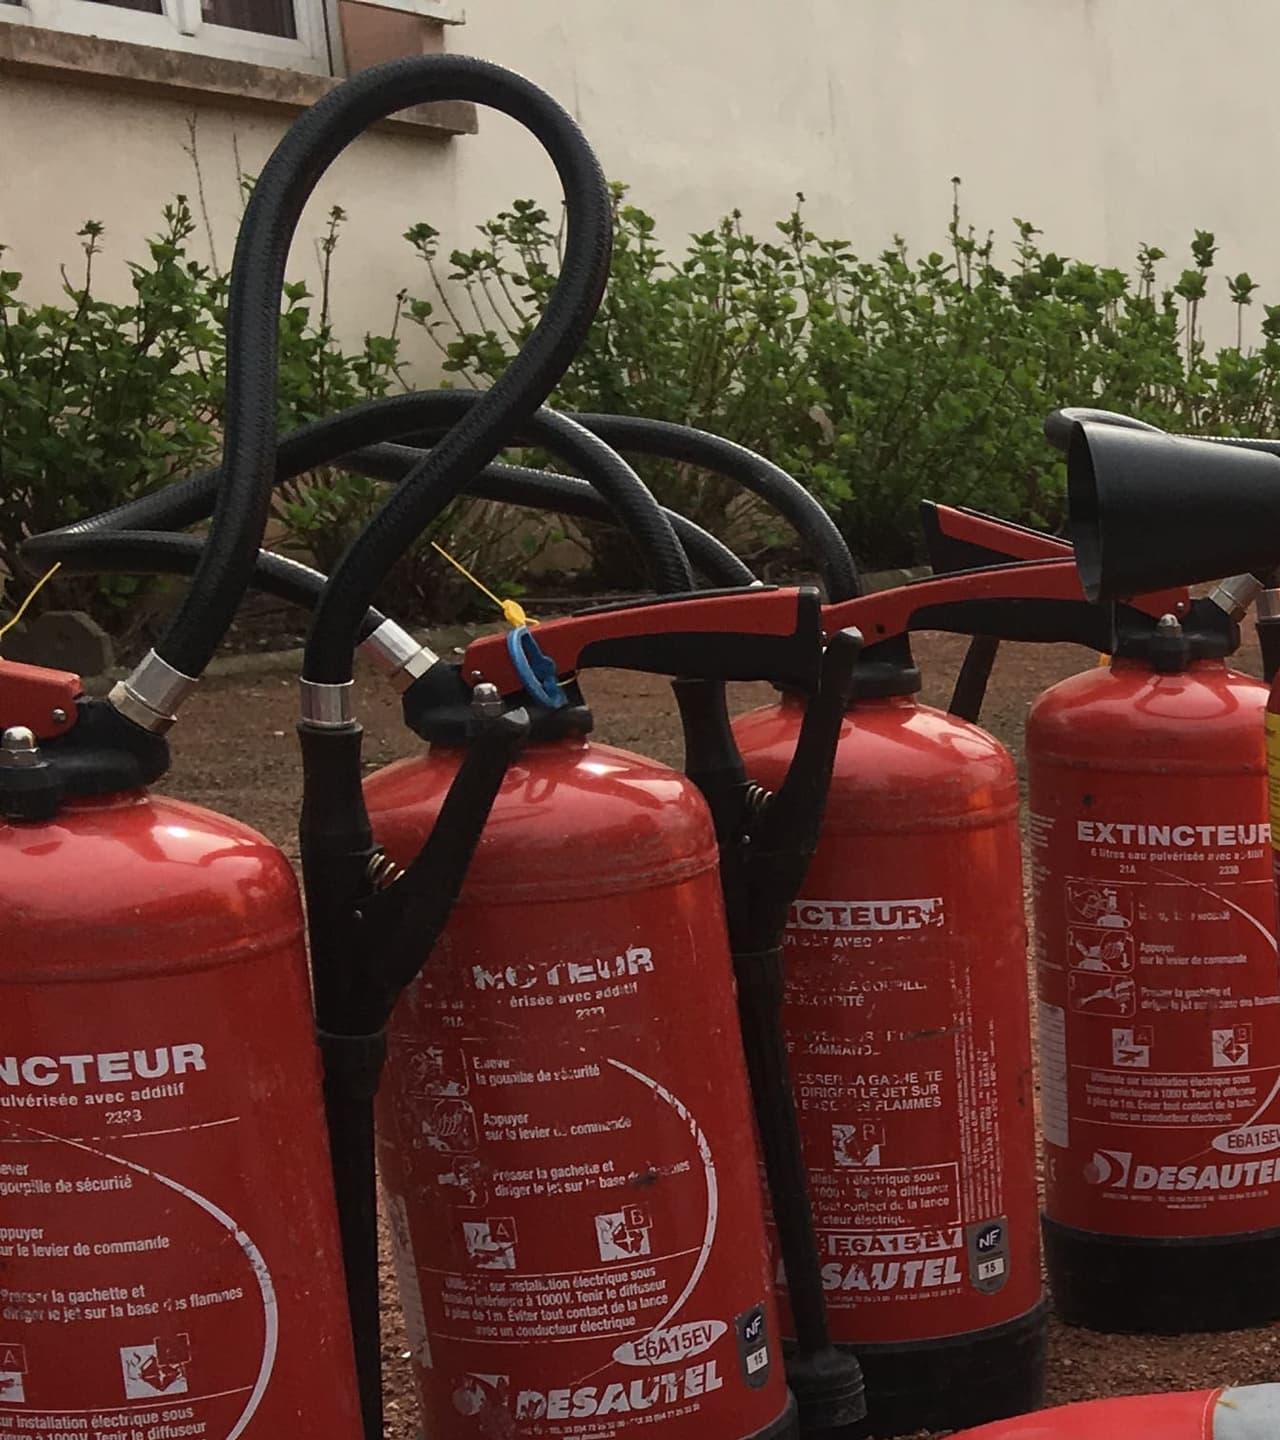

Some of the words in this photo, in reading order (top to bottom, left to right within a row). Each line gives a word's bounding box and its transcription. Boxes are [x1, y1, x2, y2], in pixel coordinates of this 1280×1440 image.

[1077, 820, 1273, 848] EXTINCTEUR
[0, 1043, 207, 1086] NCTEUR
[85, 1091, 125, 1105] avec
[131, 1082, 185, 1102] additif
[496, 1223, 511, 1239] A
[630, 1210, 645, 1226] B
[33, 1242, 71, 1258] levier
[75, 1240, 91, 1256] de
[977, 1228, 1001, 1249] NF
[820, 1255, 963, 1291] SAUTEL
[69, 1286, 128, 1306] gachette
[127, 1300, 159, 1316] base
[744, 1314, 763, 1340] NF
[632, 1322, 713, 1362] E6A15EV
[515, 1359, 724, 1421] DESAUTEL
[162, 1406, 194, 1424] sous
